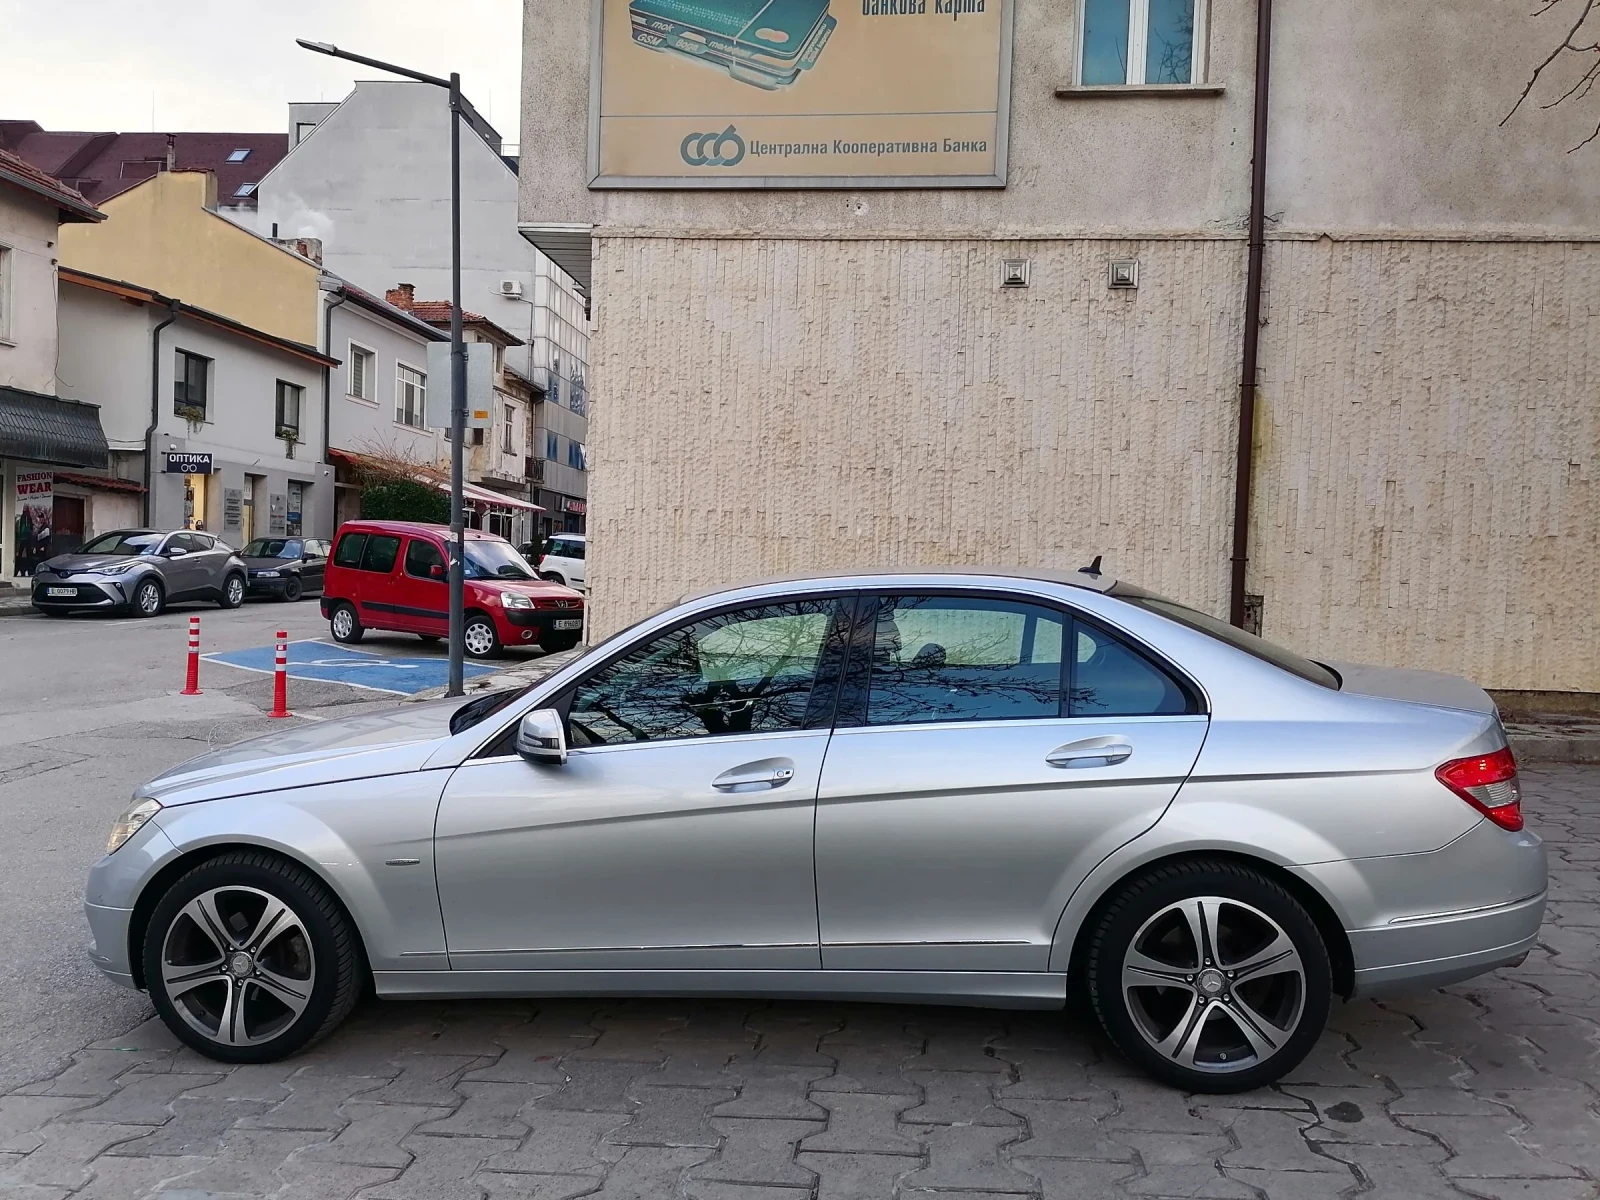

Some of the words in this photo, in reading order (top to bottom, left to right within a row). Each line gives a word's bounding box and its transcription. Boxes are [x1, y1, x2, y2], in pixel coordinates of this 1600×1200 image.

[935, 0, 985, 21] карта
[637, 33, 662, 47] GSM
[750, 140, 828, 158] Централна
[833, 139, 938, 157] Кооперативна
[943, 138, 987, 153] Банка
[169, 453, 210, 464] ОПТИКА
[17, 471, 52, 482] FASHION
[17, 482, 52, 494] WEAR
